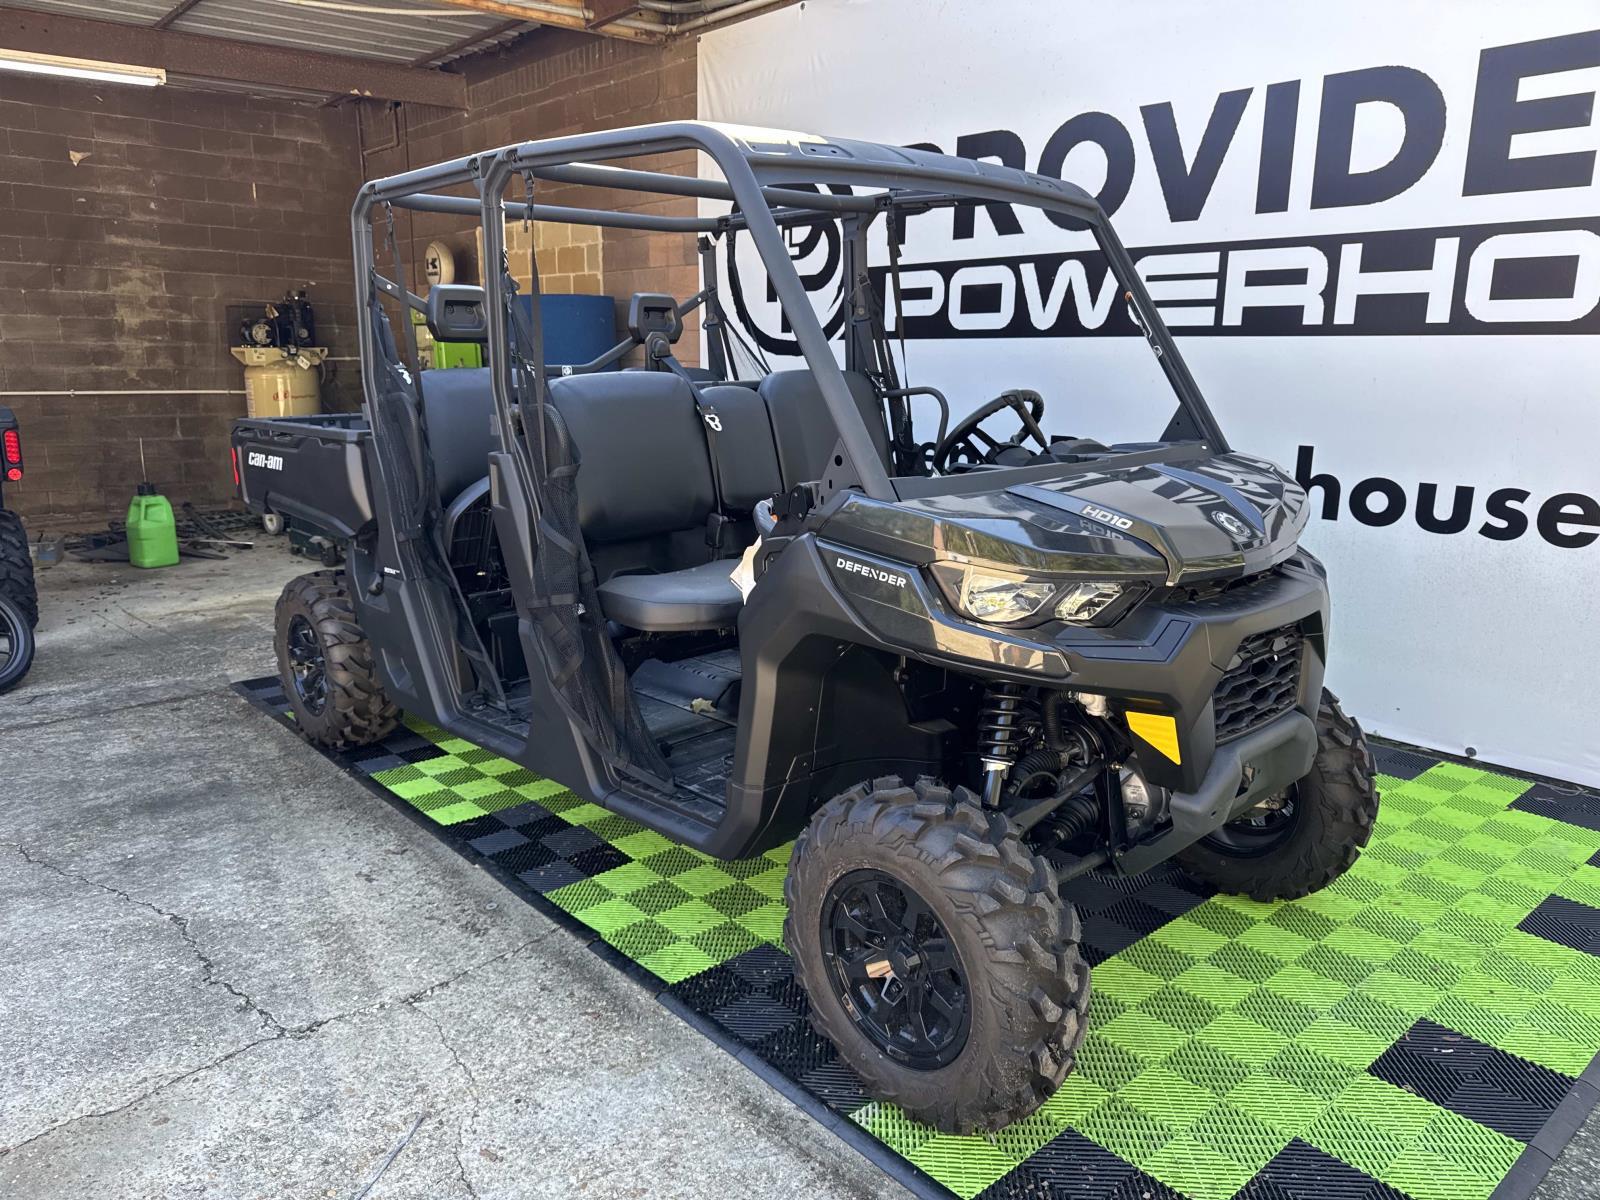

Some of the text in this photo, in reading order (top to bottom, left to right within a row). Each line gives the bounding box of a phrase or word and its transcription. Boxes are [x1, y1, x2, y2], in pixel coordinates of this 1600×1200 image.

[884, 229, 1600, 333] POWERHO
[248, 451, 284, 471] can-am
[1294, 444, 1600, 549] house
[1081, 504, 1134, 530] HD10
[836, 557, 907, 589] DEFENDER
